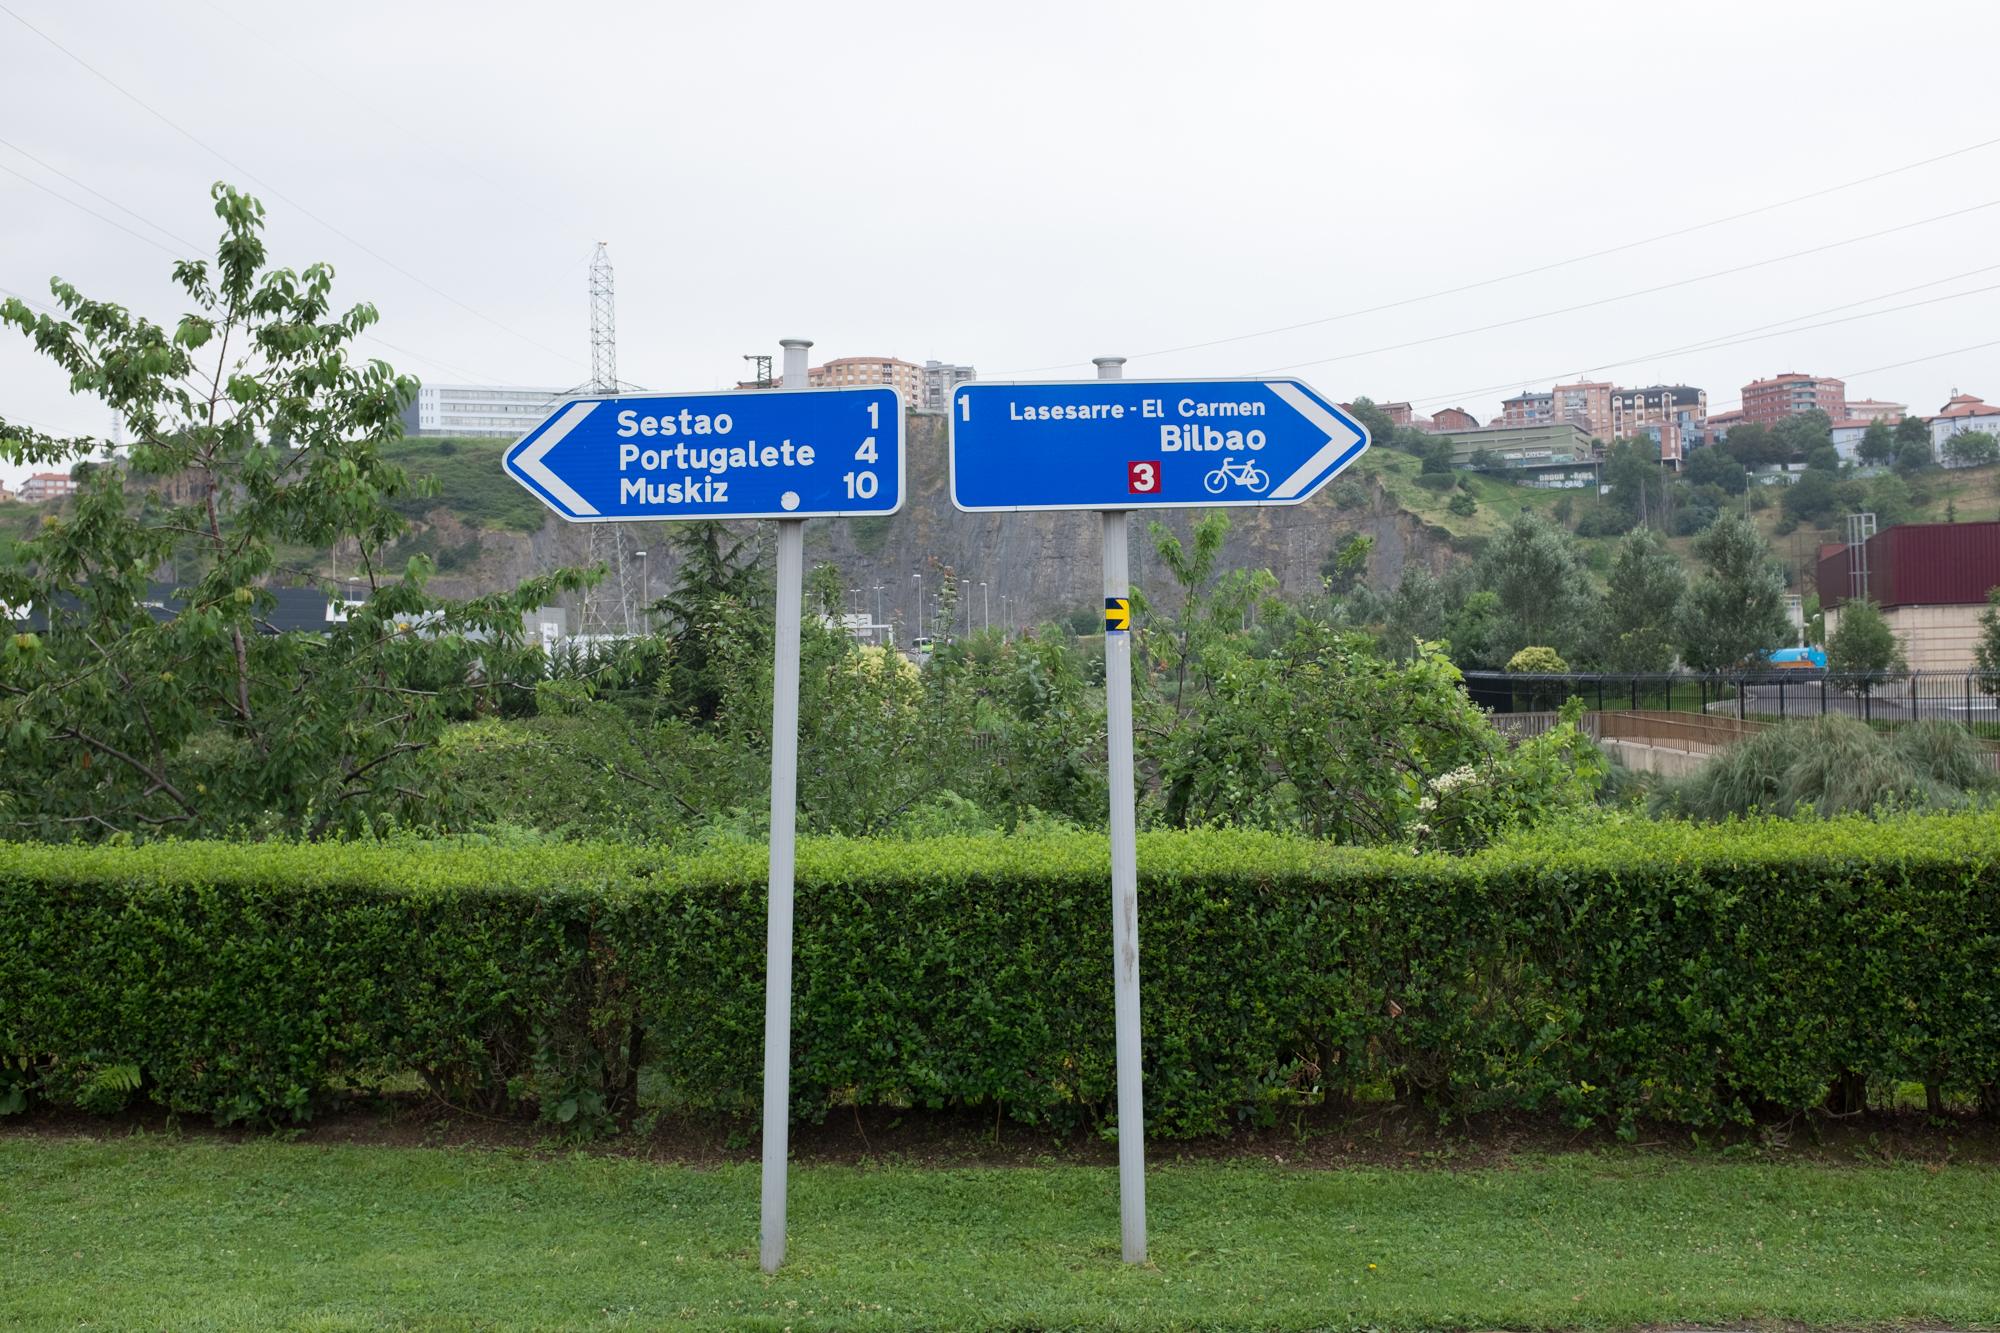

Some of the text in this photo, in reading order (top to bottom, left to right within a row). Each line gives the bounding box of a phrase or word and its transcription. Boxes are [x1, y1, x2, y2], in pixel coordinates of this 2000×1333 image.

[617, 403, 878, 437] Sestao 1
[958, 395, 969, 421] 1
[1011, 402, 1124, 420] Lasesarre
[1143, 400, 1164, 417] El
[1178, 399, 1265, 417] Carmen
[1161, 424, 1266, 451] Bilbao
[620, 437, 878, 474] Portugalete 4
[621, 471, 878, 504] Muskiz 10
[1134, 464, 1154, 491] 3
